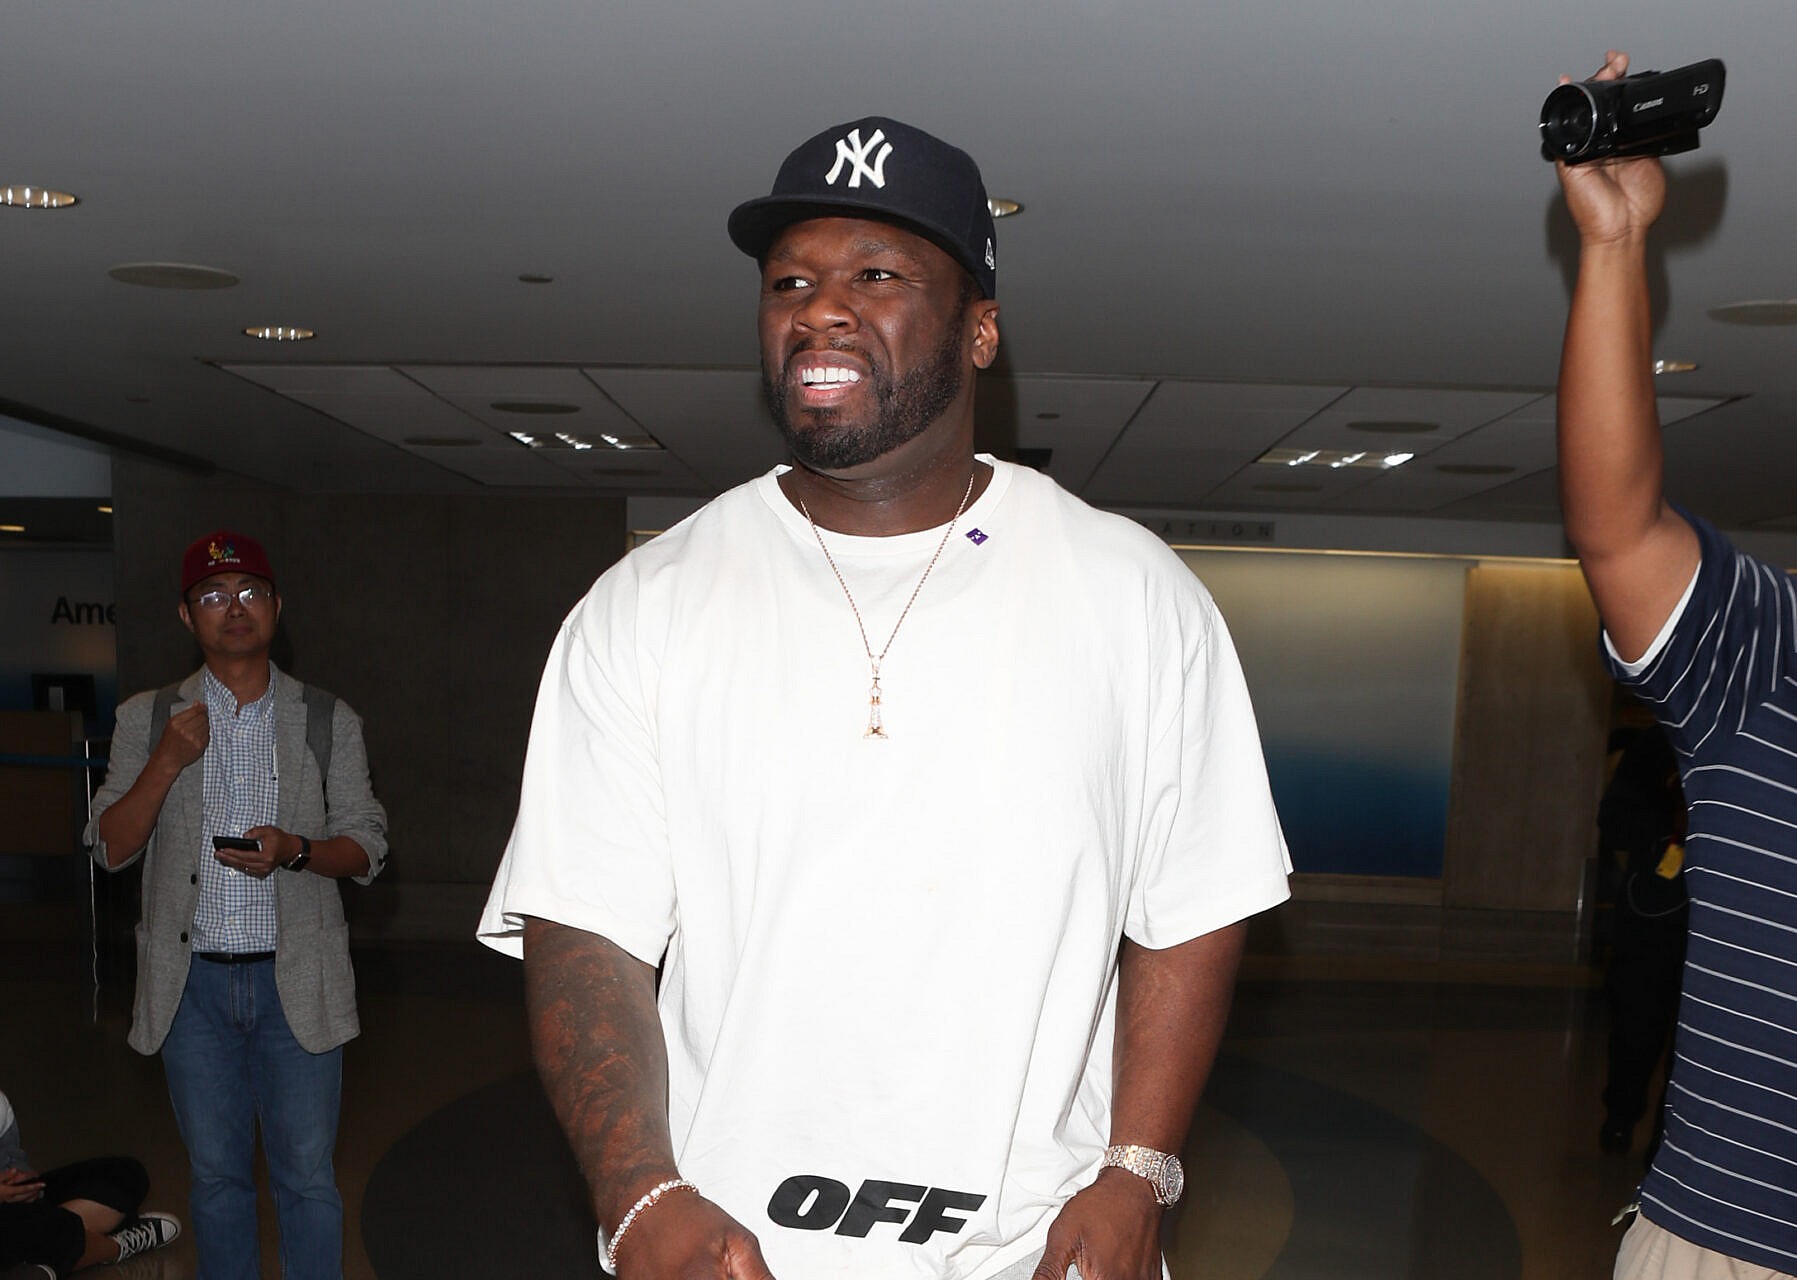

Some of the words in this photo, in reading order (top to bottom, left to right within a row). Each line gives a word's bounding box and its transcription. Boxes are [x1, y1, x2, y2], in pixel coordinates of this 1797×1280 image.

[824, 127, 894, 189] NY
[1143, 520, 1271, 537] ATION
[767, 1174, 988, 1245] OFF
